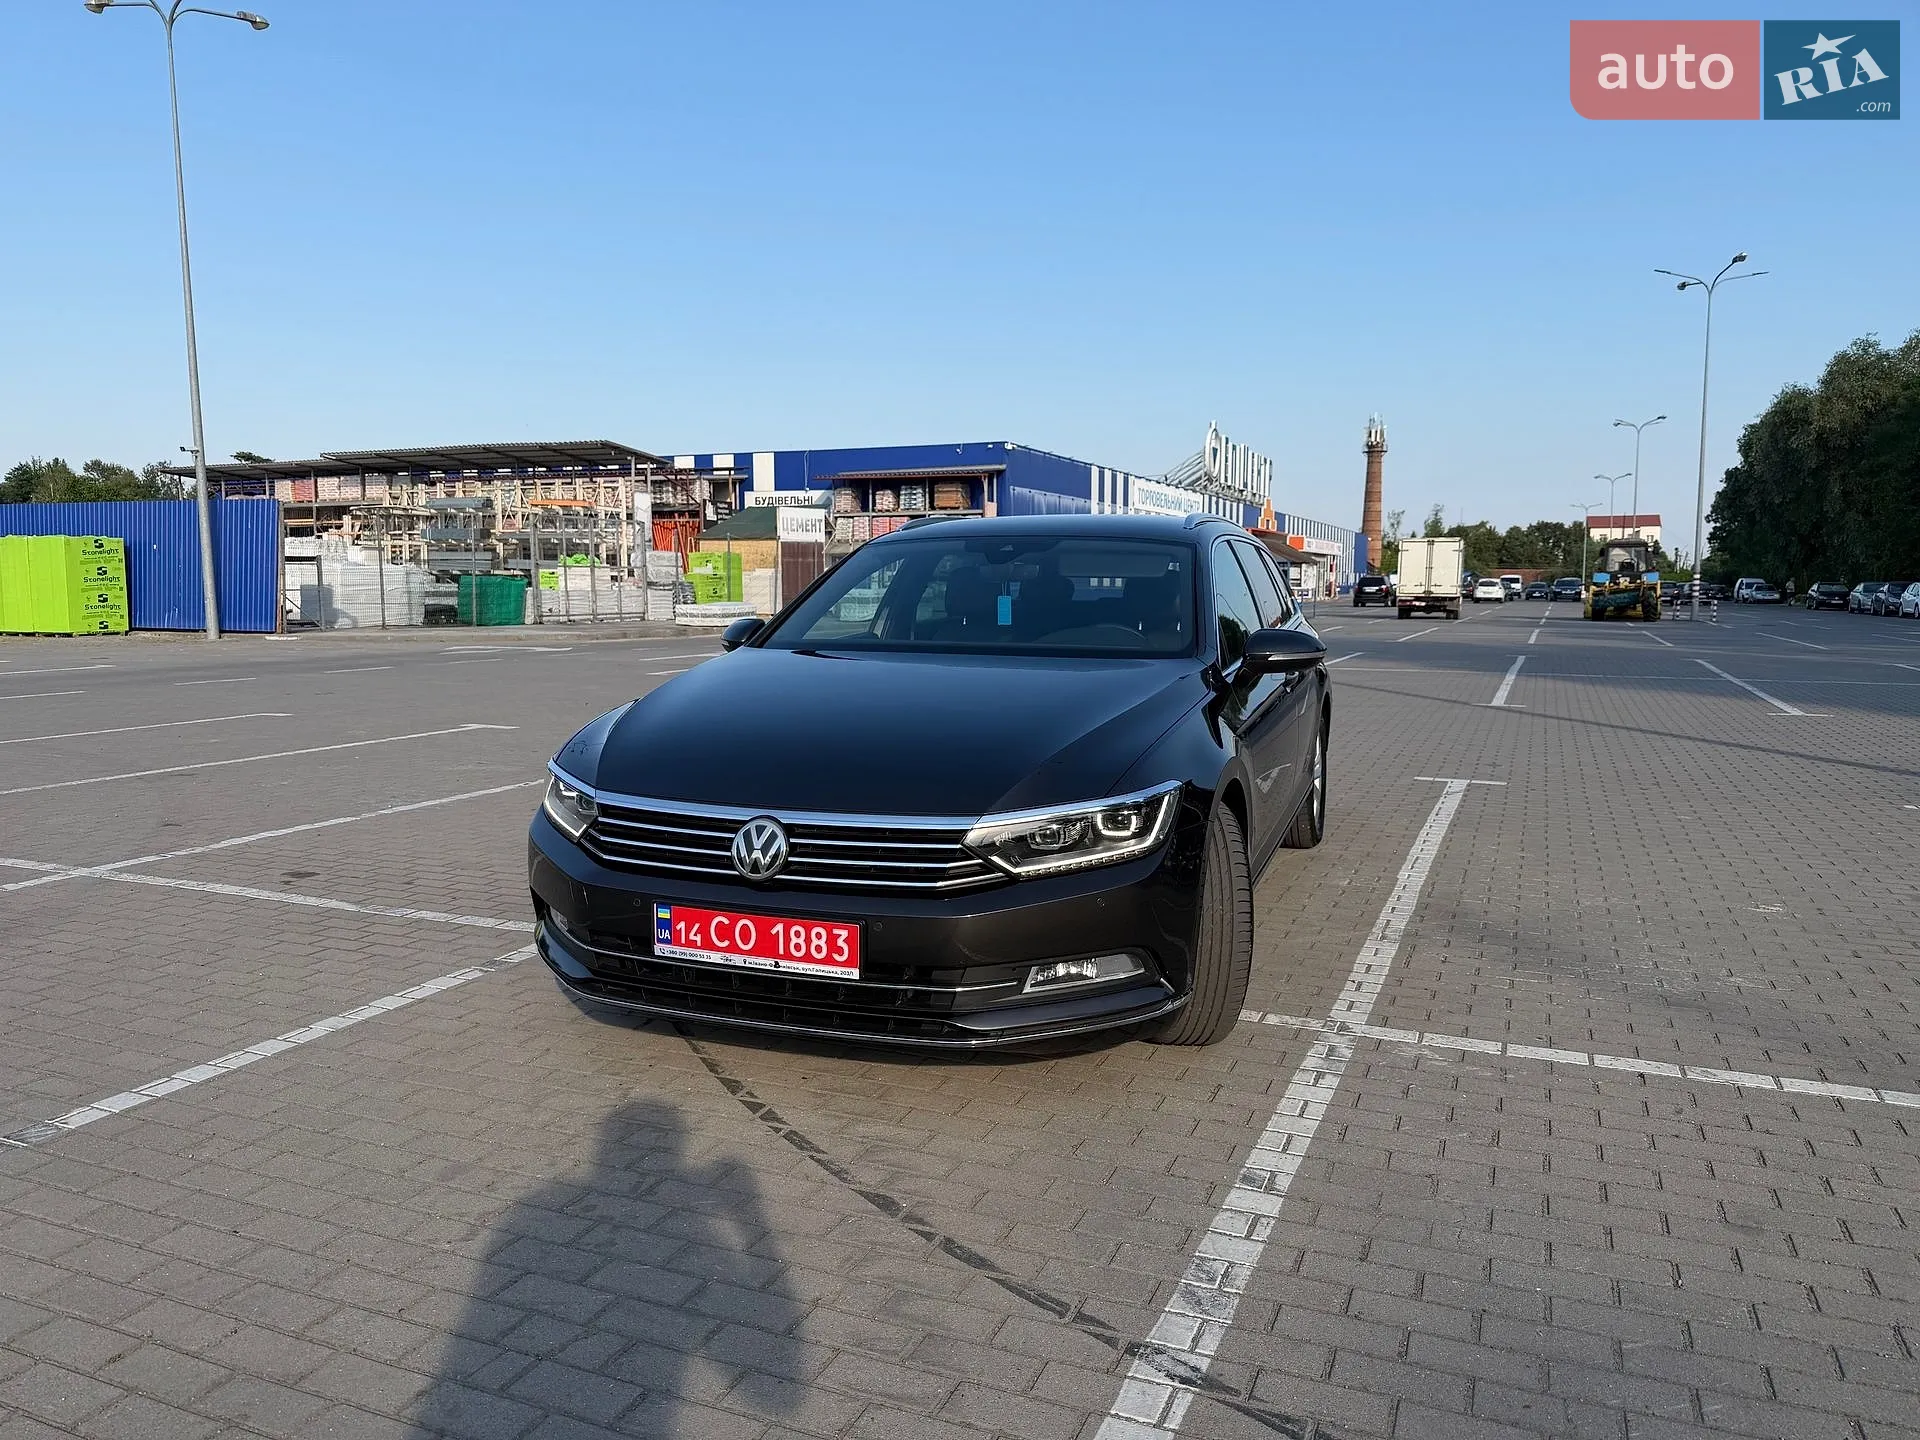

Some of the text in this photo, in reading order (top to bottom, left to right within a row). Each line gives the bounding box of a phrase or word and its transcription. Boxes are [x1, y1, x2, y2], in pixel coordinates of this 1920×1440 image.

[755, 495, 814, 506] БУДІВЕЛЬНІ
[782, 517, 823, 535] ЦЕМЕНТ
[658, 928, 671, 940] UA
[675, 920, 702, 947] 14
[770, 922, 850, 963] 1883
